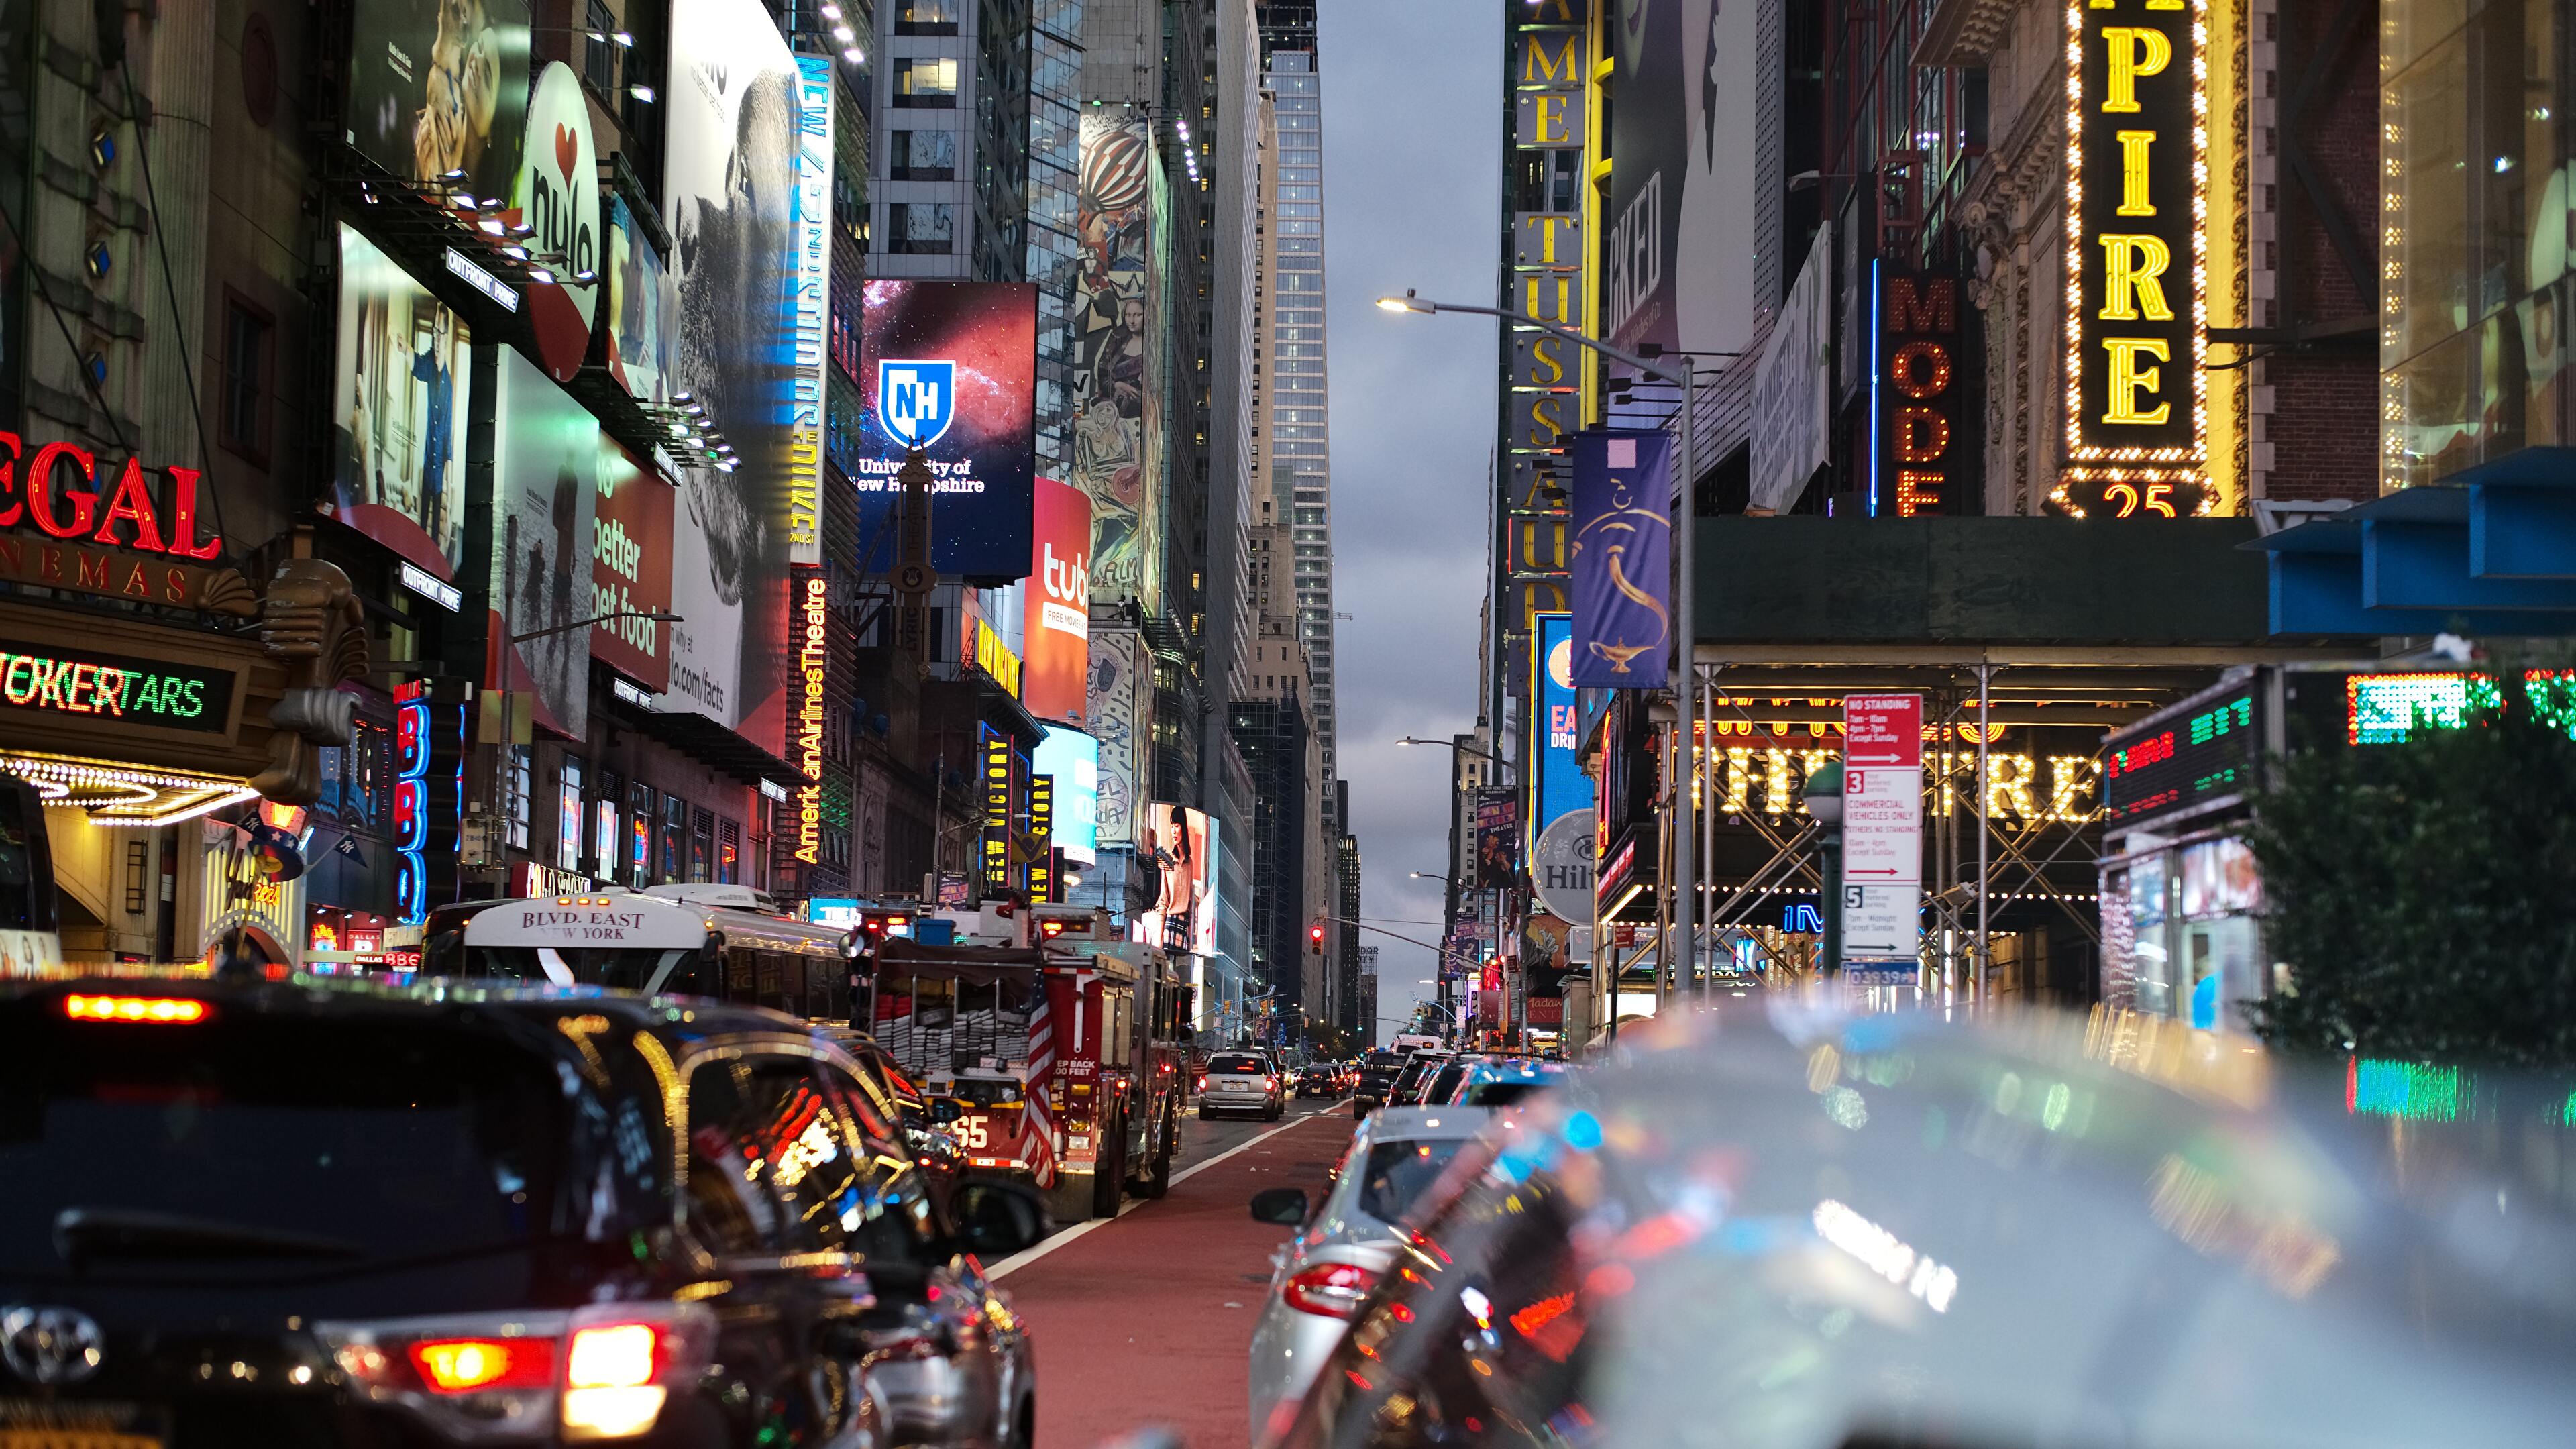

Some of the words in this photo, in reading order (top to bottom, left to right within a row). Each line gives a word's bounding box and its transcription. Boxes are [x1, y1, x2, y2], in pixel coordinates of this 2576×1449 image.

[2090, 0, 2186, 425] PIRE
[449, 250, 493, 294] OUTFRONT
[494, 281, 517, 311] PRIME
[1521, 215, 1571, 629] TUSSAUD
[953, 460, 971, 474] of
[402, 565, 440, 600] OUTFRONT
[441, 585, 460, 610] PRIME
[621, 587, 656, 657] food
[1048, 610, 1063, 623] FREE
[1849, 700, 1863, 710] NO
[1864, 699, 1911, 710] STANDING
[988, 739, 1008, 827] VICTORY
[1848, 773, 1862, 793] 3
[1032, 778, 1050, 836] CTORY
[1849, 800, 1904, 809] COMMERCIAL
[1849, 811, 1889, 820] VEHICLES
[1891, 811, 1914, 820] ONLY
[1030, 868, 1048, 903] NEW
[1846, 888, 1861, 908] 5
[523, 912, 582, 928] BLVD.
[590, 912, 645, 929] EAST
[583, 928, 624, 939] YORK
[1069, 1067, 1091, 1075] FEET
[1070, 1059, 1095, 1068] BACK
